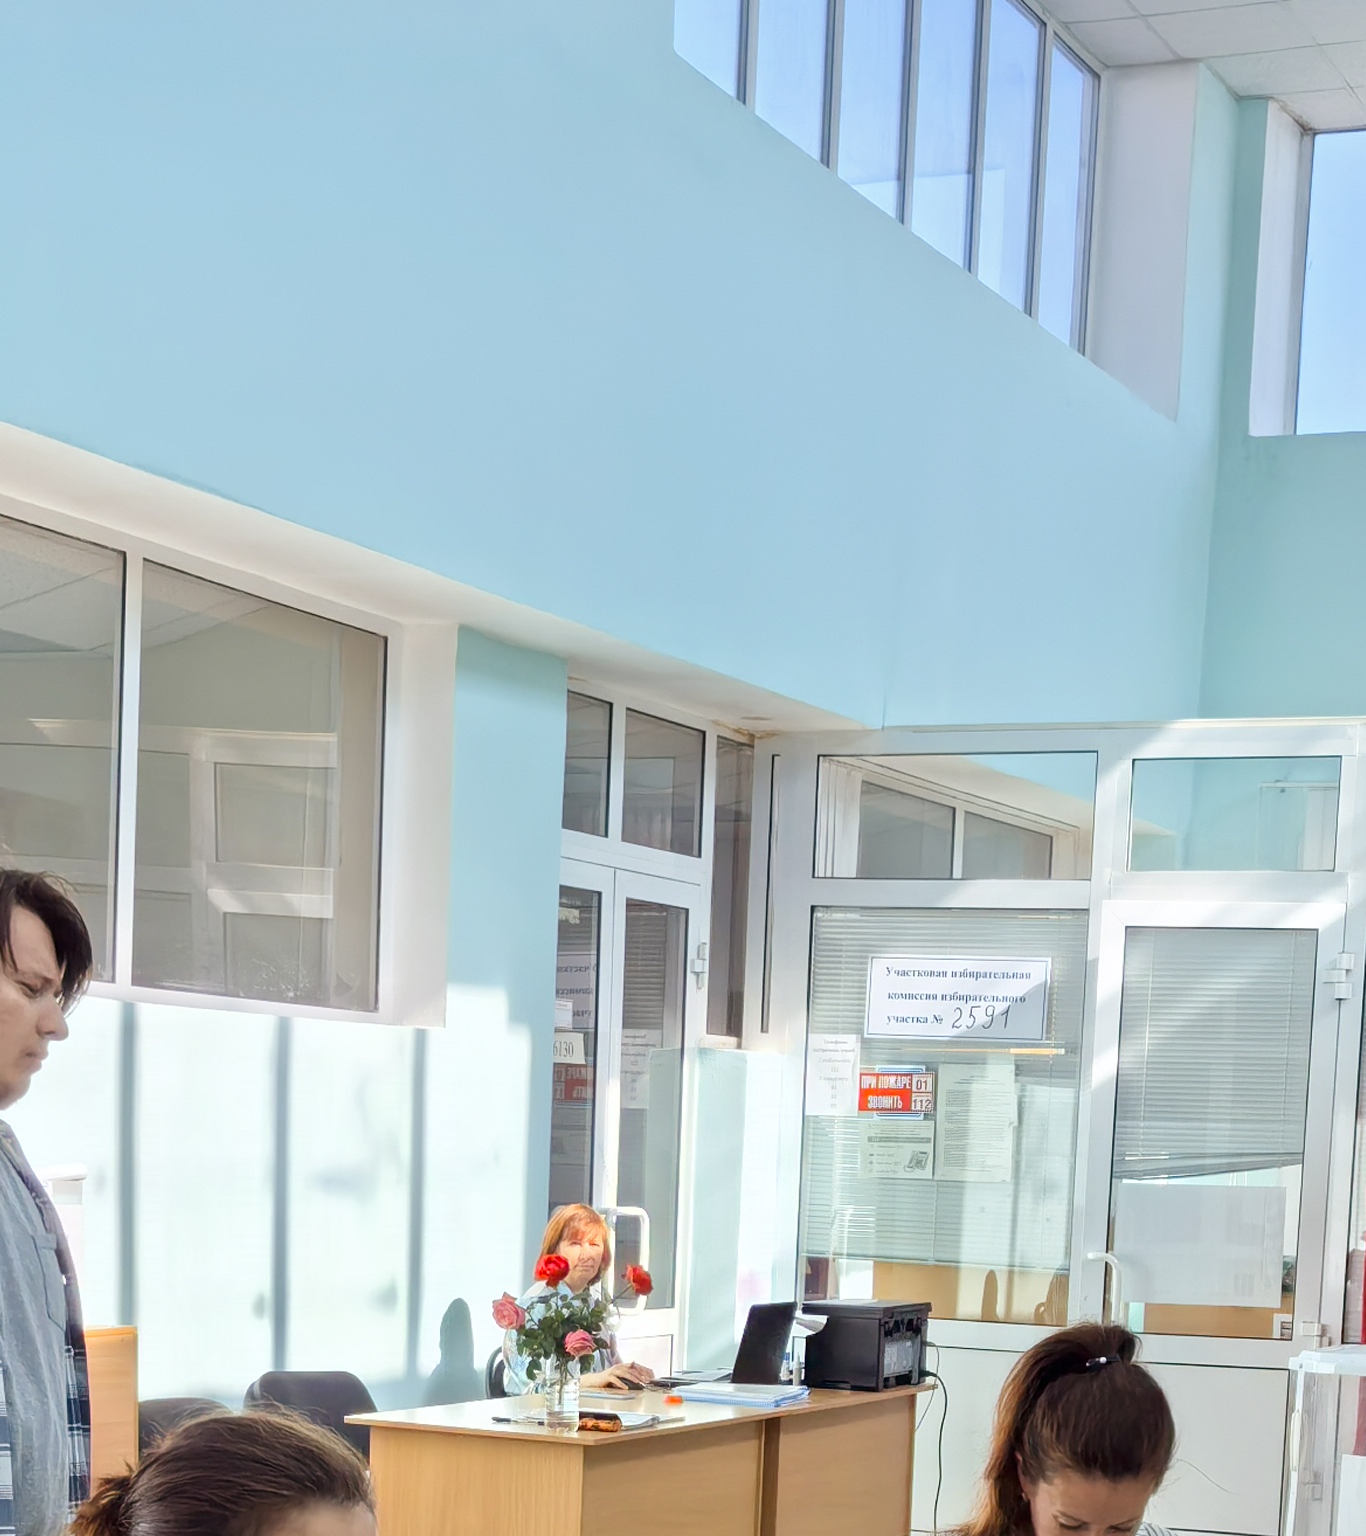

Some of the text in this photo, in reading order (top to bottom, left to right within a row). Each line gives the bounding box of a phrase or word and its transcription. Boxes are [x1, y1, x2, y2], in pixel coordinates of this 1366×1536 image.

[885, 966, 1031, 981] Участковая избирательная
[887, 991, 1027, 1004] комиссия избирательного
[886, 1004, 1011, 1029] участка № 2591
[860, 1075, 877, 1089] ПРИ
[878, 1075, 912, 1089] ПОЖАРЕ
[915, 1079, 928, 1090] 01
[867, 1095, 903, 1109] ЗВОНИТЬ
[912, 1098, 932, 1110] 112
